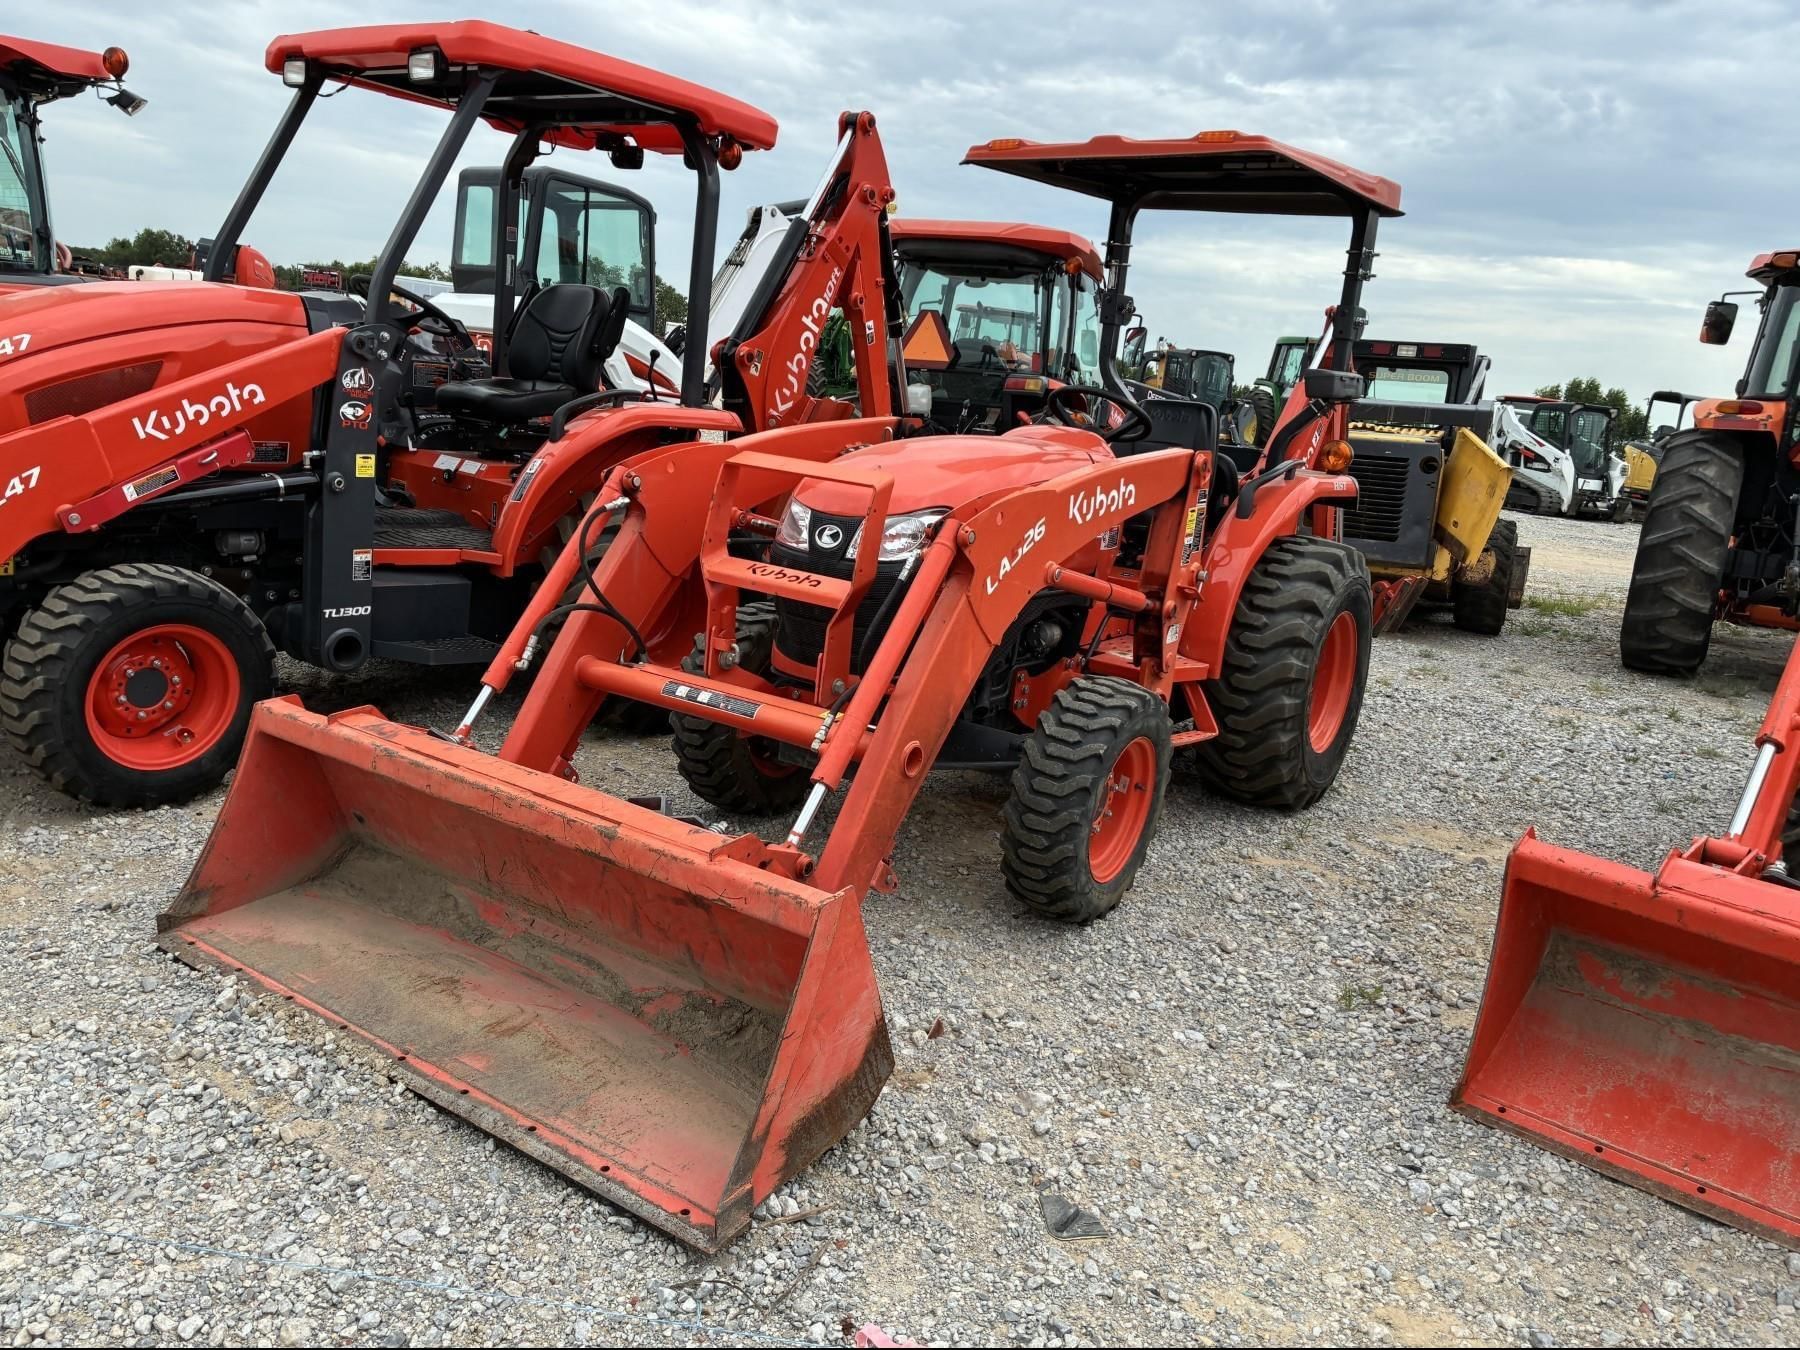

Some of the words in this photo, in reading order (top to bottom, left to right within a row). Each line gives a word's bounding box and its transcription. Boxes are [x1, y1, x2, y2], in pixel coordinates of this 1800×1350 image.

[767, 297, 828, 421] Kubota
[823, 266, 841, 303] 10ft
[1368, 371, 1405, 381] SUPER
[1407, 373, 1441, 383] BOOM
[131, 382, 266, 441] Kubota
[1068, 477, 1136, 525] Kubota
[746, 563, 822, 588] Kubota
[322, 605, 372, 618] TL1300
